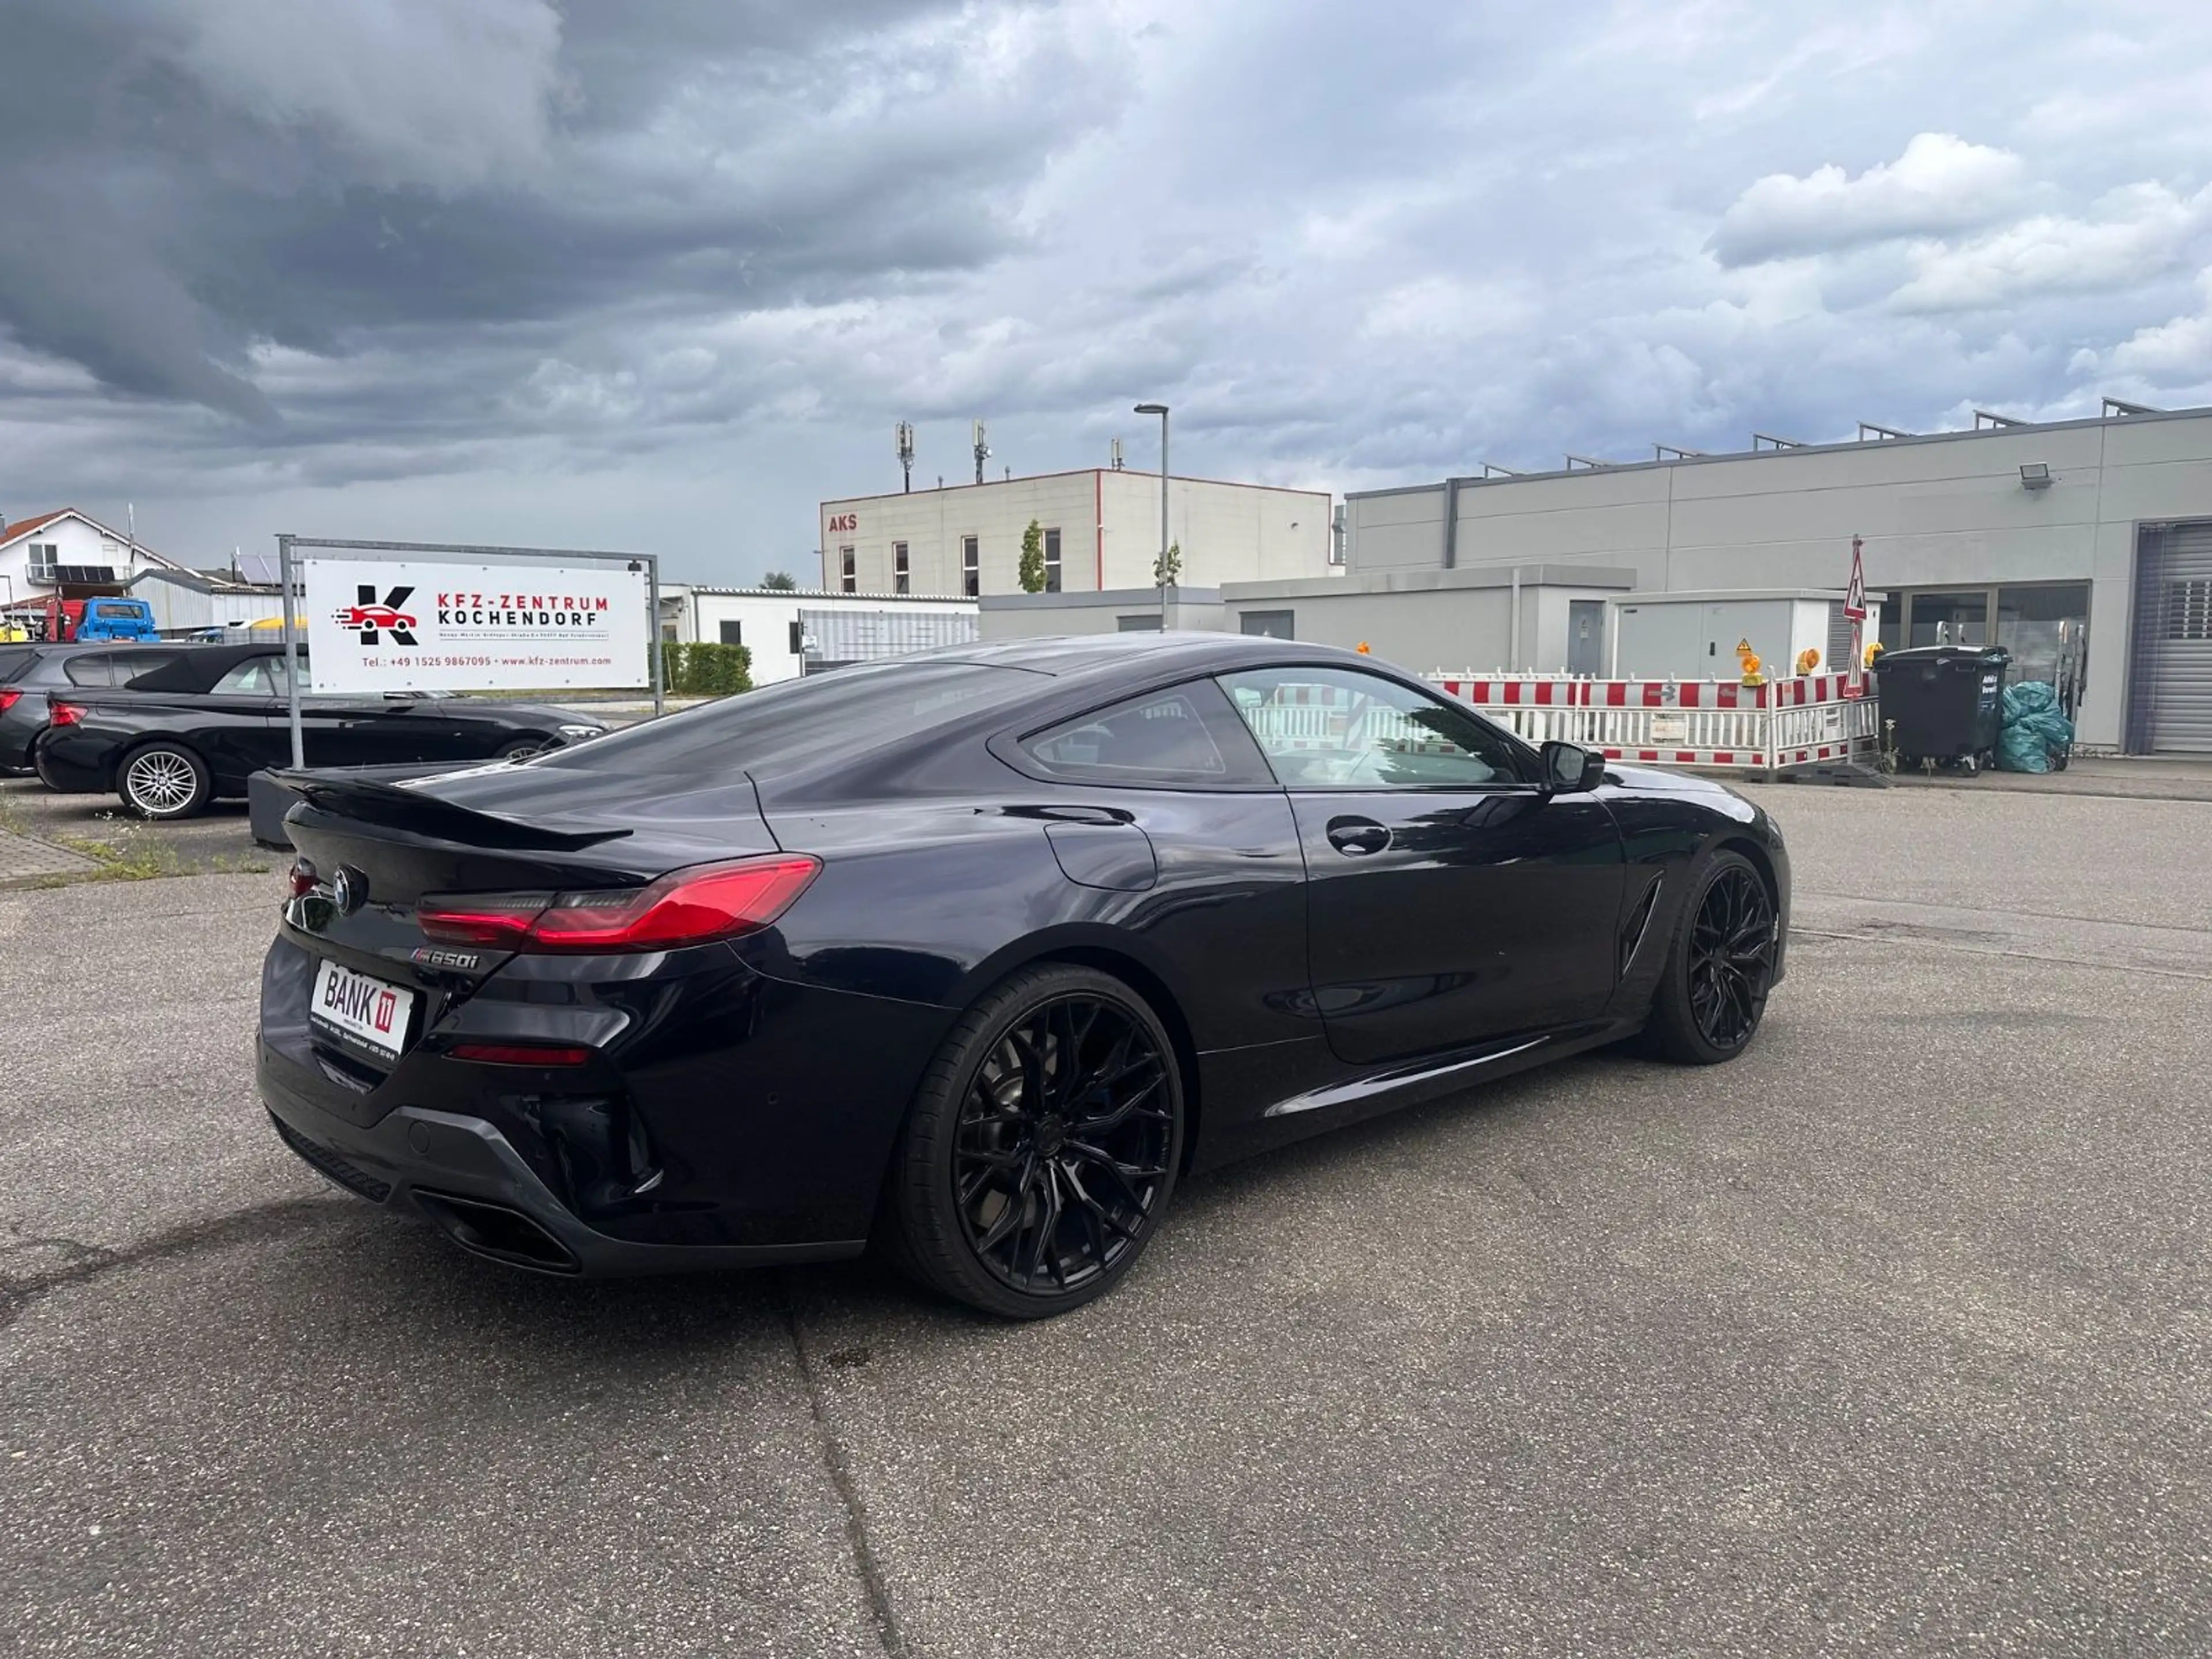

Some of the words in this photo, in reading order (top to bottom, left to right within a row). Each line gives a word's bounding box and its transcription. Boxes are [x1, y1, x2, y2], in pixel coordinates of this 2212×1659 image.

[829, 514, 857, 531] AKS
[438, 593, 608, 611] KFZ-ZENTRUM
[438, 610, 596, 626] KOCHENDORF
[362, 657, 387, 666] Tel.:
[391, 657, 410, 666] +49
[415, 657, 441, 666] 1525
[502, 656, 611, 666] www.kfz-zentrum.com
[324, 970, 377, 1025] BANK
